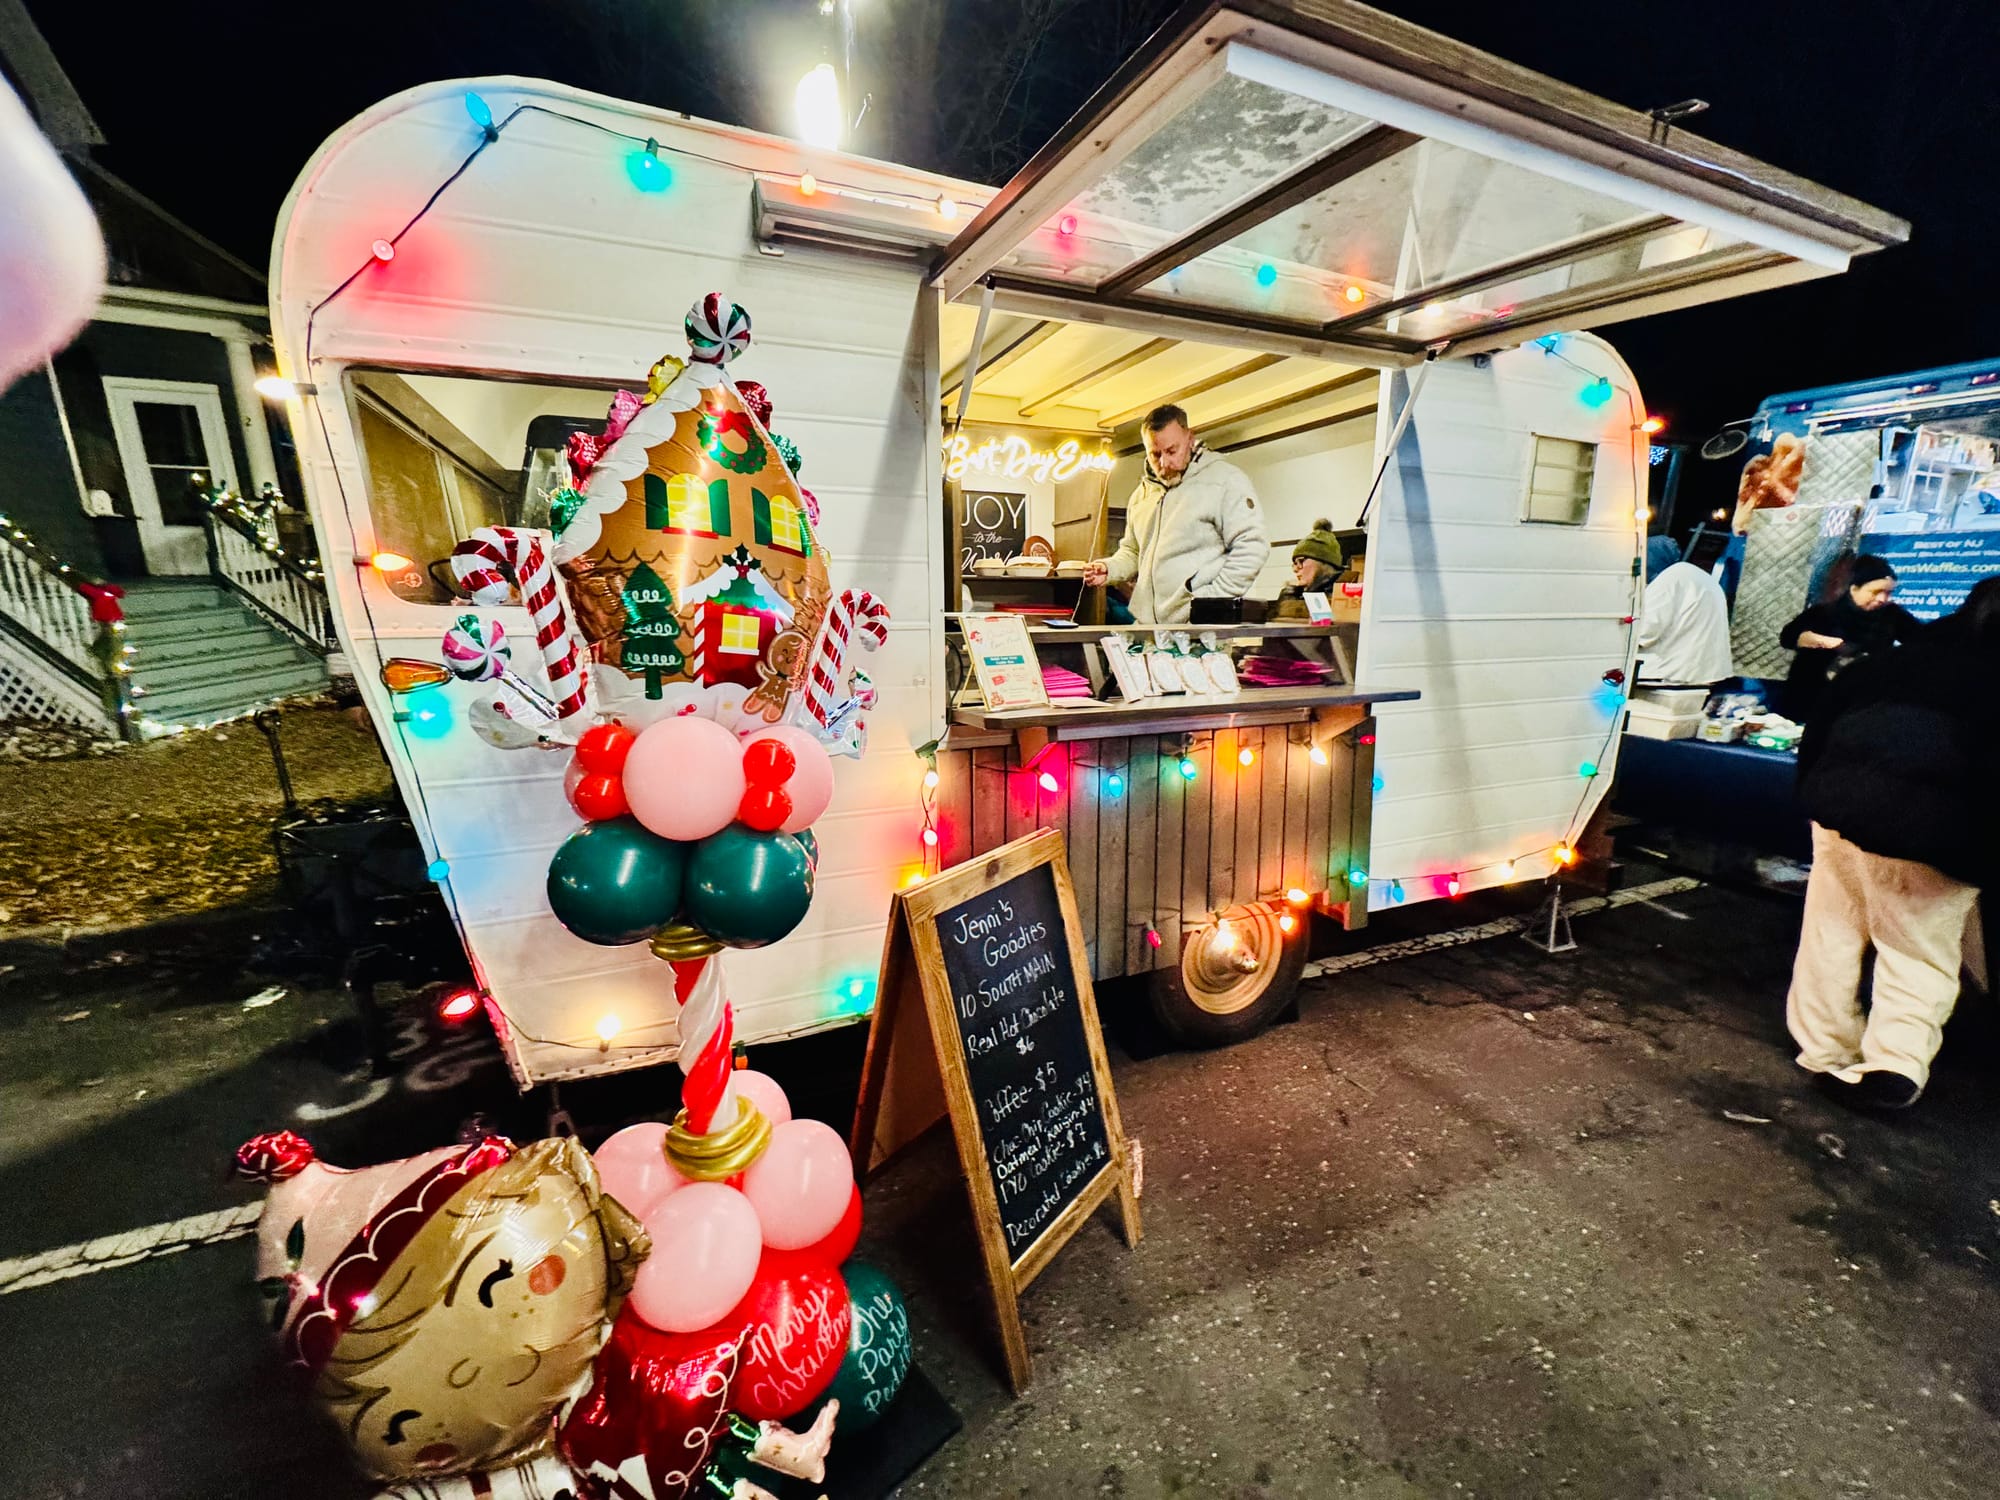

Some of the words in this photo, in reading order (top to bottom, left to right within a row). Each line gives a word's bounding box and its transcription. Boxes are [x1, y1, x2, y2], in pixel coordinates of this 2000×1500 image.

[943, 436, 1003, 479] Best
[1001, 436, 1055, 484] Day
[1053, 440, 1117, 481] Ever
[961, 494, 1026, 530] JOY
[973, 530, 985, 543] to
[985, 531, 1002, 544] the
[954, 900, 1014, 945] Jenni's
[984, 921, 1047, 968] Goodies
[960, 994, 977, 1019] 10
[1023, 951, 1057, 983] MAIN
[967, 1027, 998, 1059] Real
[999, 1013, 1020, 1041] Hot
[997, 1136, 1042, 1180] Oatmeal
[747, 1289, 830, 1375] Merry
[859, 1303, 908, 1384] Party
